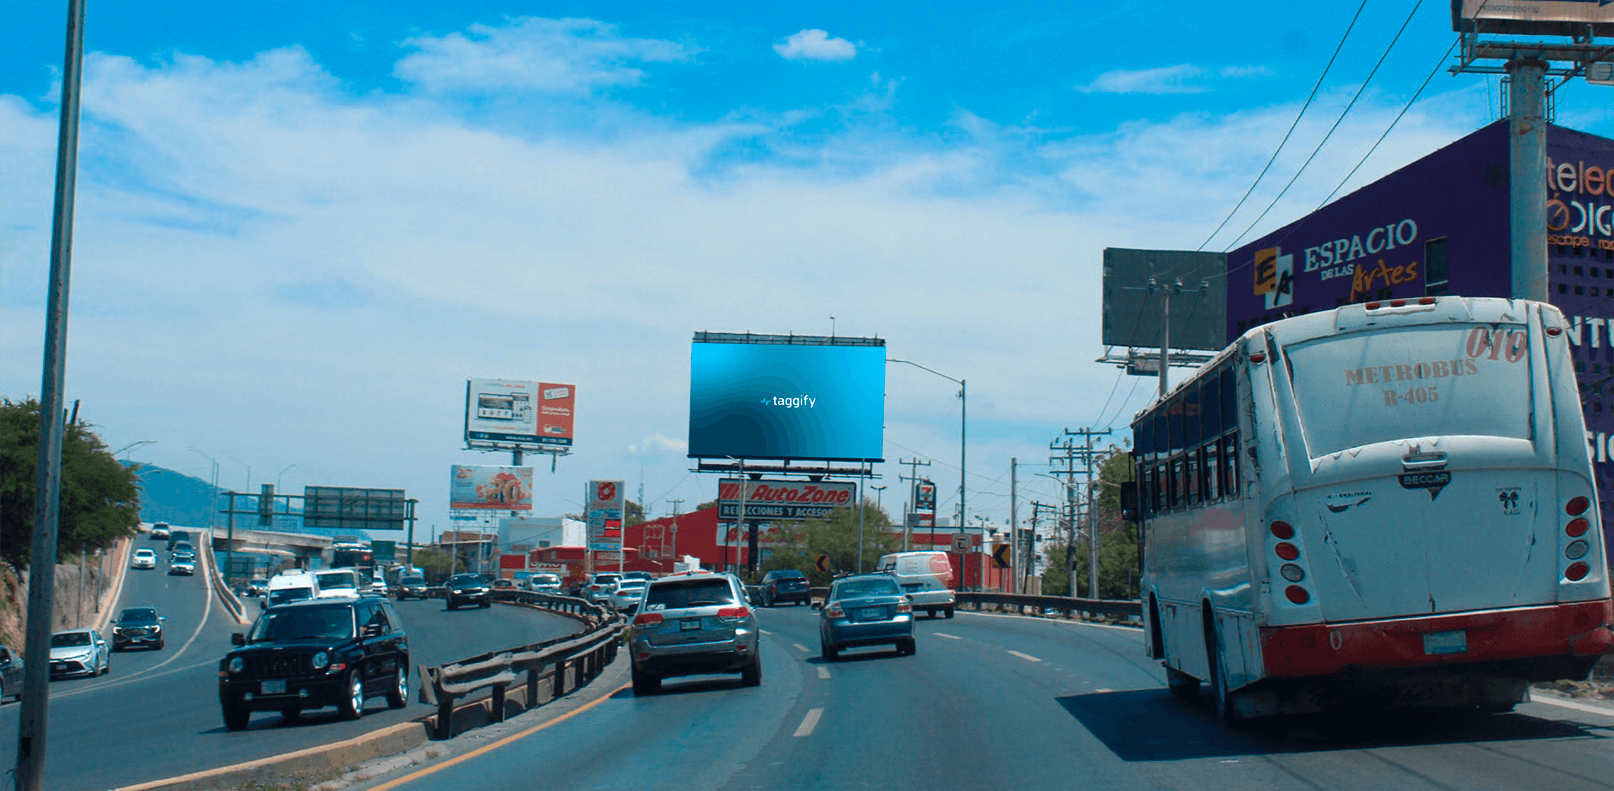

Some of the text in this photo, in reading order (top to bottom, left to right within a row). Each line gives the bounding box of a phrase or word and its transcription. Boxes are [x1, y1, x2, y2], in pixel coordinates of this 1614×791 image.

[1303, 218, 1418, 273] ESPACIO
[1320, 263, 1354, 281] DE LAS
[1350, 259, 1418, 303] Artes
[1466, 326, 1528, 364] 010
[1345, 358, 1478, 386] METROBUS
[772, 394, 816, 409] taggify
[1383, 386, 1439, 407] R-405
[1404, 474, 1449, 485] BECCAR
[751, 484, 850, 505] AutoZone
[787, 507, 793, 516] Y
